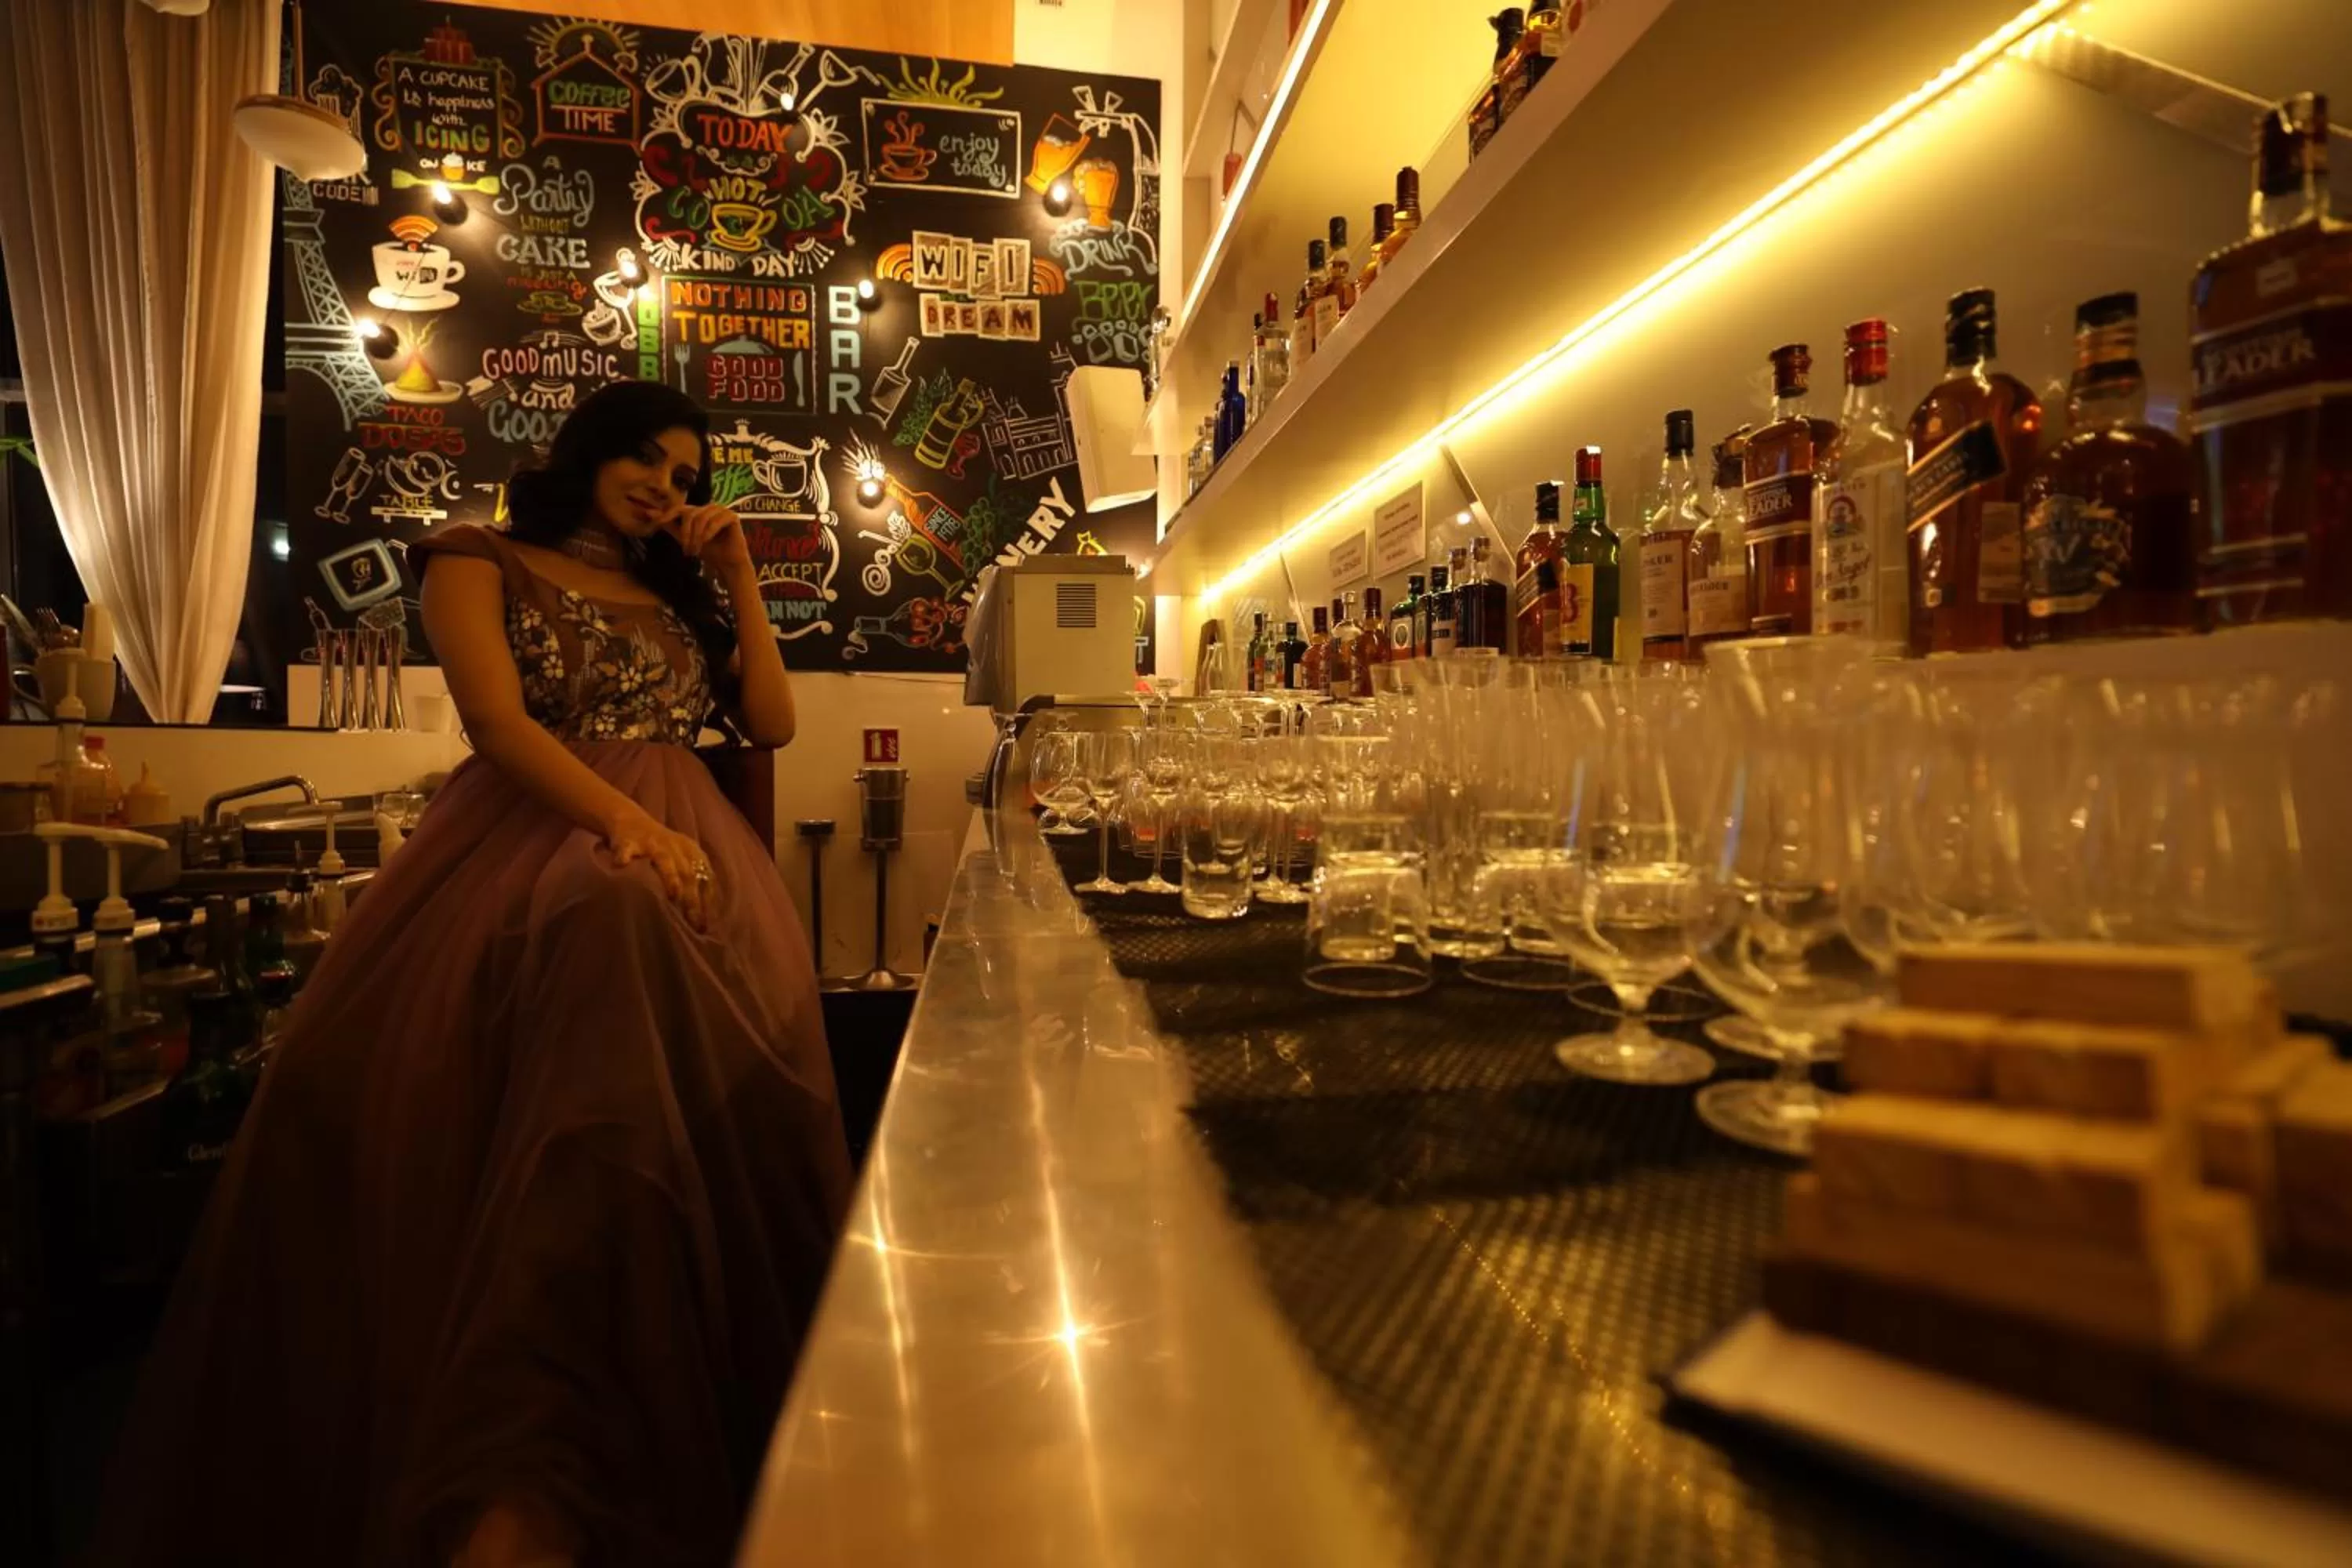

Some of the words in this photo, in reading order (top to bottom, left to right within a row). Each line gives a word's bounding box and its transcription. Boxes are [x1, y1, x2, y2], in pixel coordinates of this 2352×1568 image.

[397, 67, 414, 83] A
[419, 70, 490, 92] CUPCAKE
[551, 104, 627, 132] TIME
[414, 120, 490, 153] ICING
[696, 114, 793, 154] TODAY
[939, 133, 1000, 163] enjoy
[951, 158, 1007, 188] today
[313, 183, 361, 201] CODE
[492, 163, 595, 227] Party
[709, 176, 768, 201] HOT
[495, 233, 591, 269] CAKE
[681, 242, 736, 272] KIND
[752, 249, 795, 278] DAY
[1059, 232, 1158, 281] DRINK
[917, 245, 1017, 288] WIFI
[670, 281, 807, 313] NOTHING
[672, 310, 811, 349] TOGETHER
[927, 305, 1033, 331] DREAM
[482, 347, 539, 379] GOOD
[828, 285, 863, 415] BAR
[708, 354, 784, 380] GOOD
[521, 382, 576, 409] and
[708, 379, 786, 402] FOOD
[384, 404, 446, 426] TACO
[754, 498, 801, 514] CHANGE
[758, 561, 824, 586] ACCEPT
[785, 601, 827, 620] NOT
